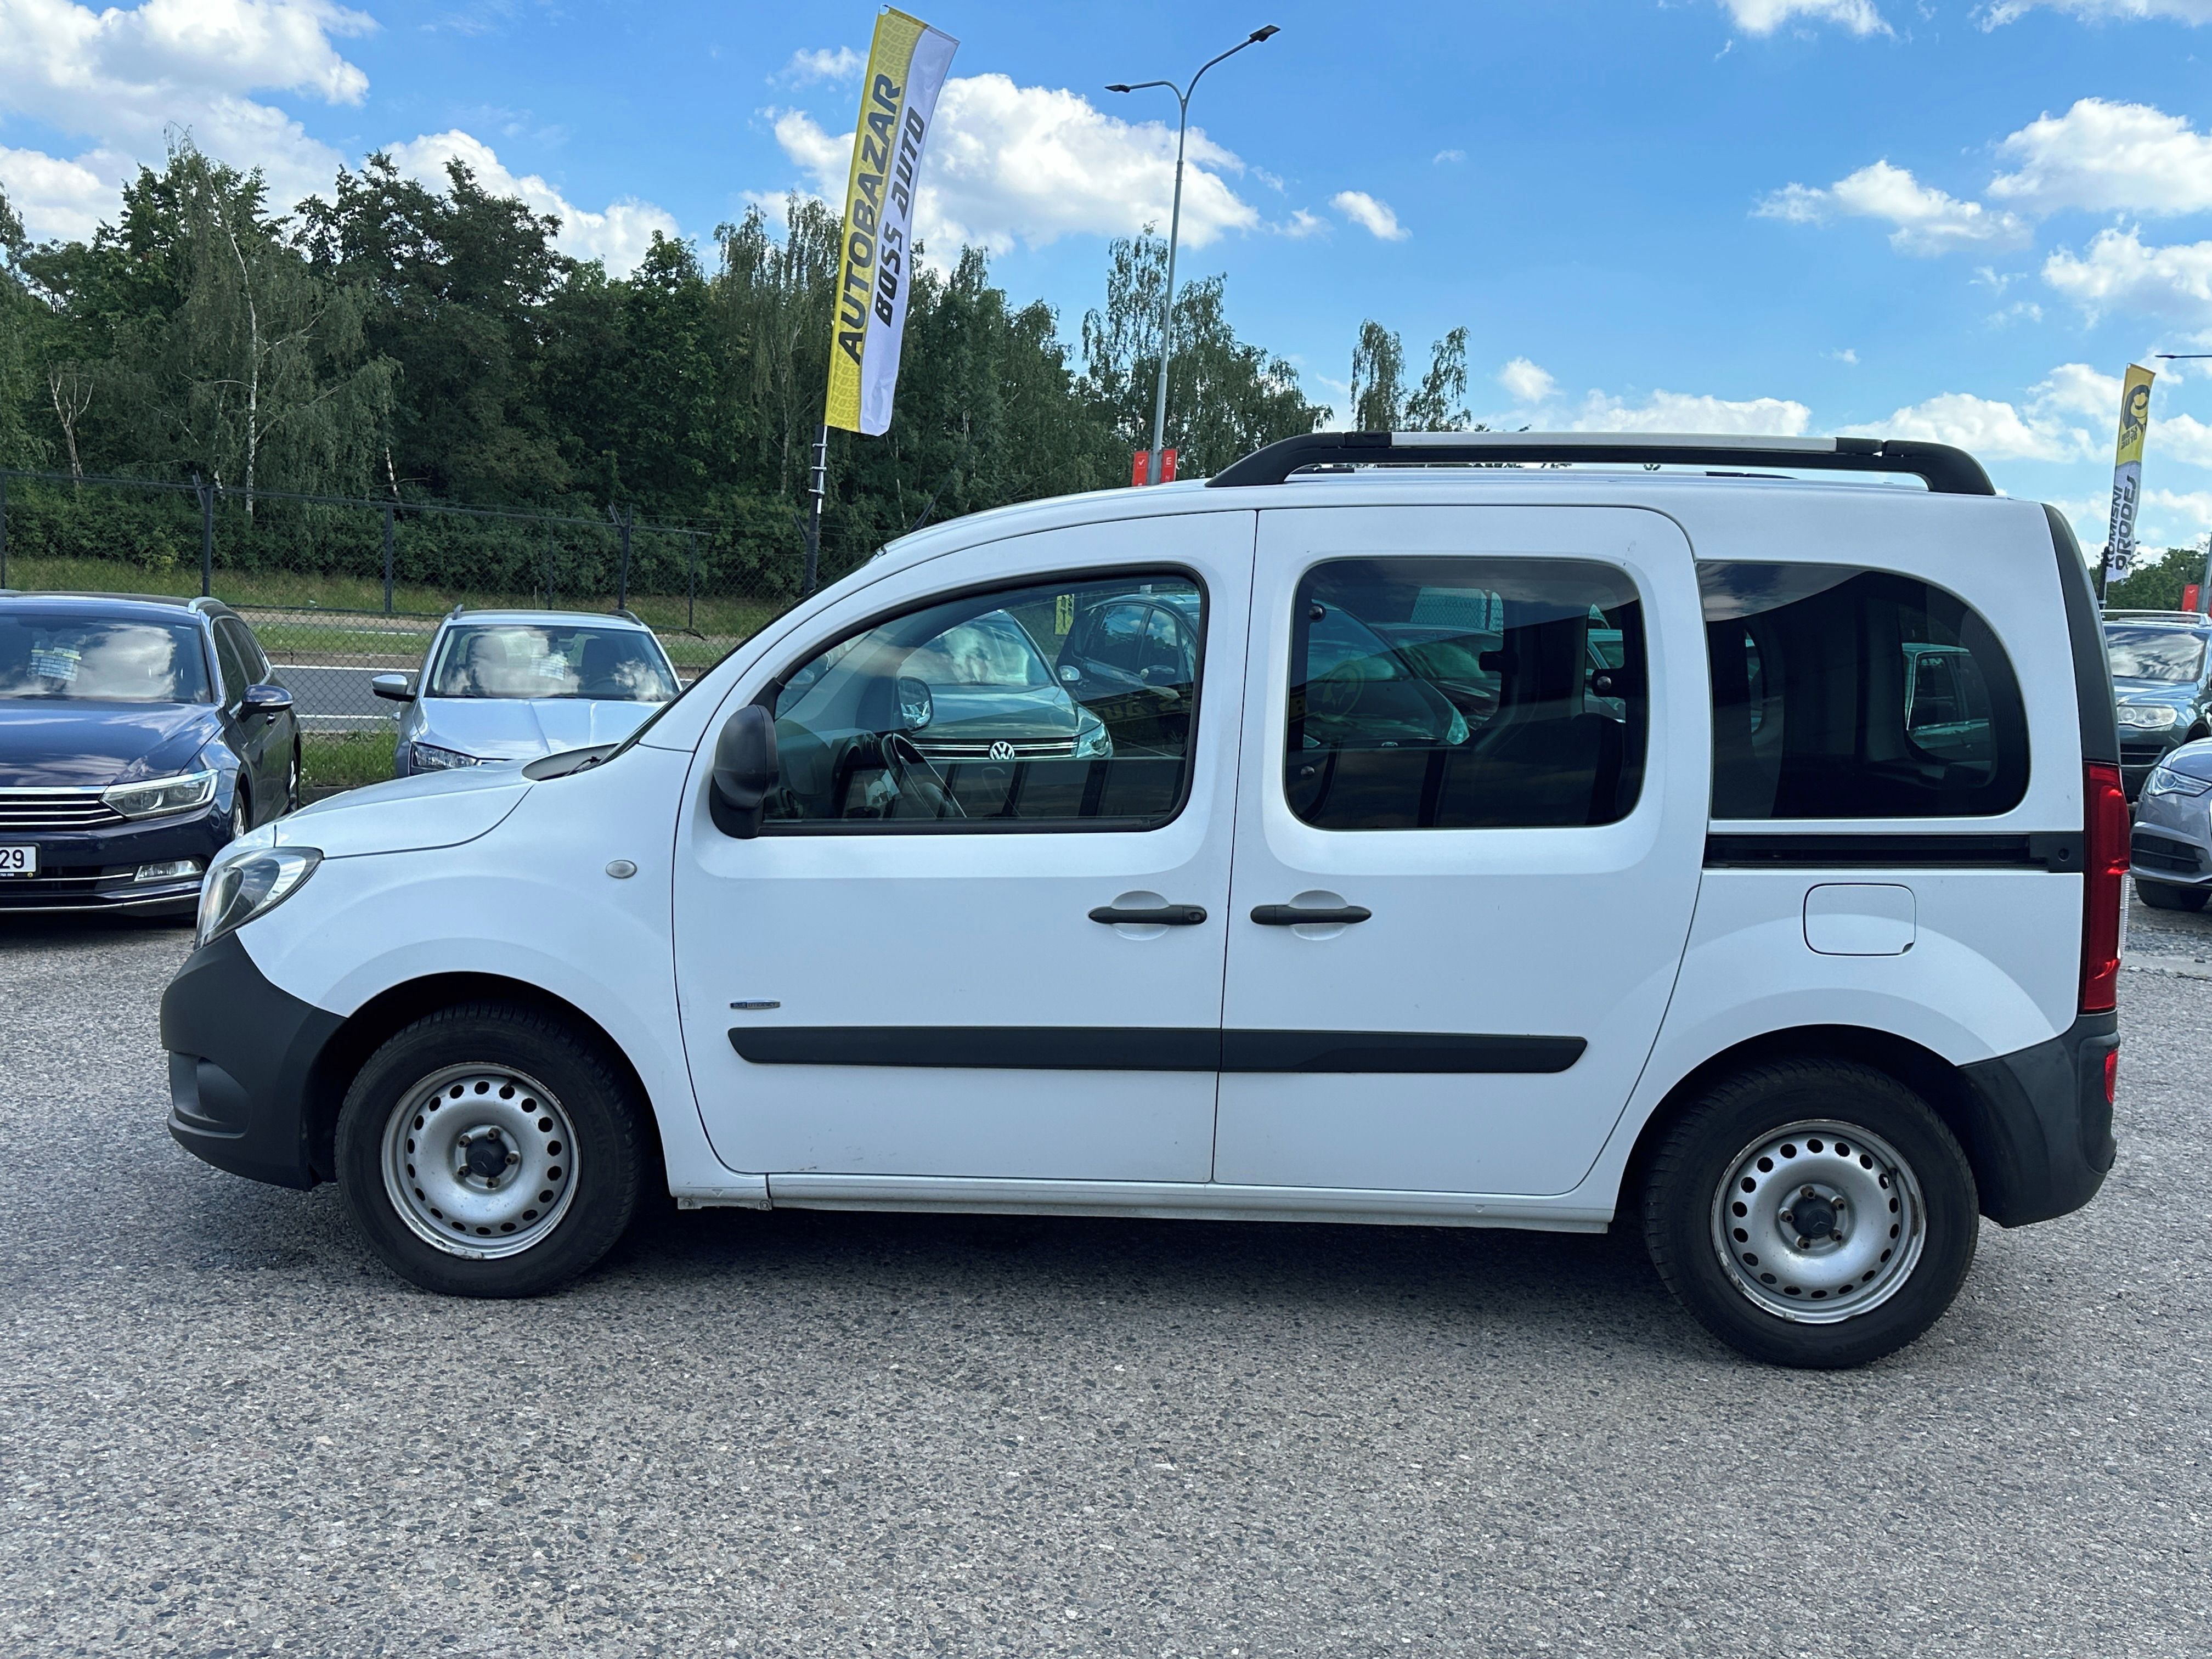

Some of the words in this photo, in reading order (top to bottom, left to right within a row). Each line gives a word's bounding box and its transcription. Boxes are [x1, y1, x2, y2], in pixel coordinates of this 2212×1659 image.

[839, 74, 901, 366] AUTOBAZAR
[875, 221, 902, 328] BOSS
[891, 106, 925, 221] AUTO
[0, 849, 25, 869] 29
